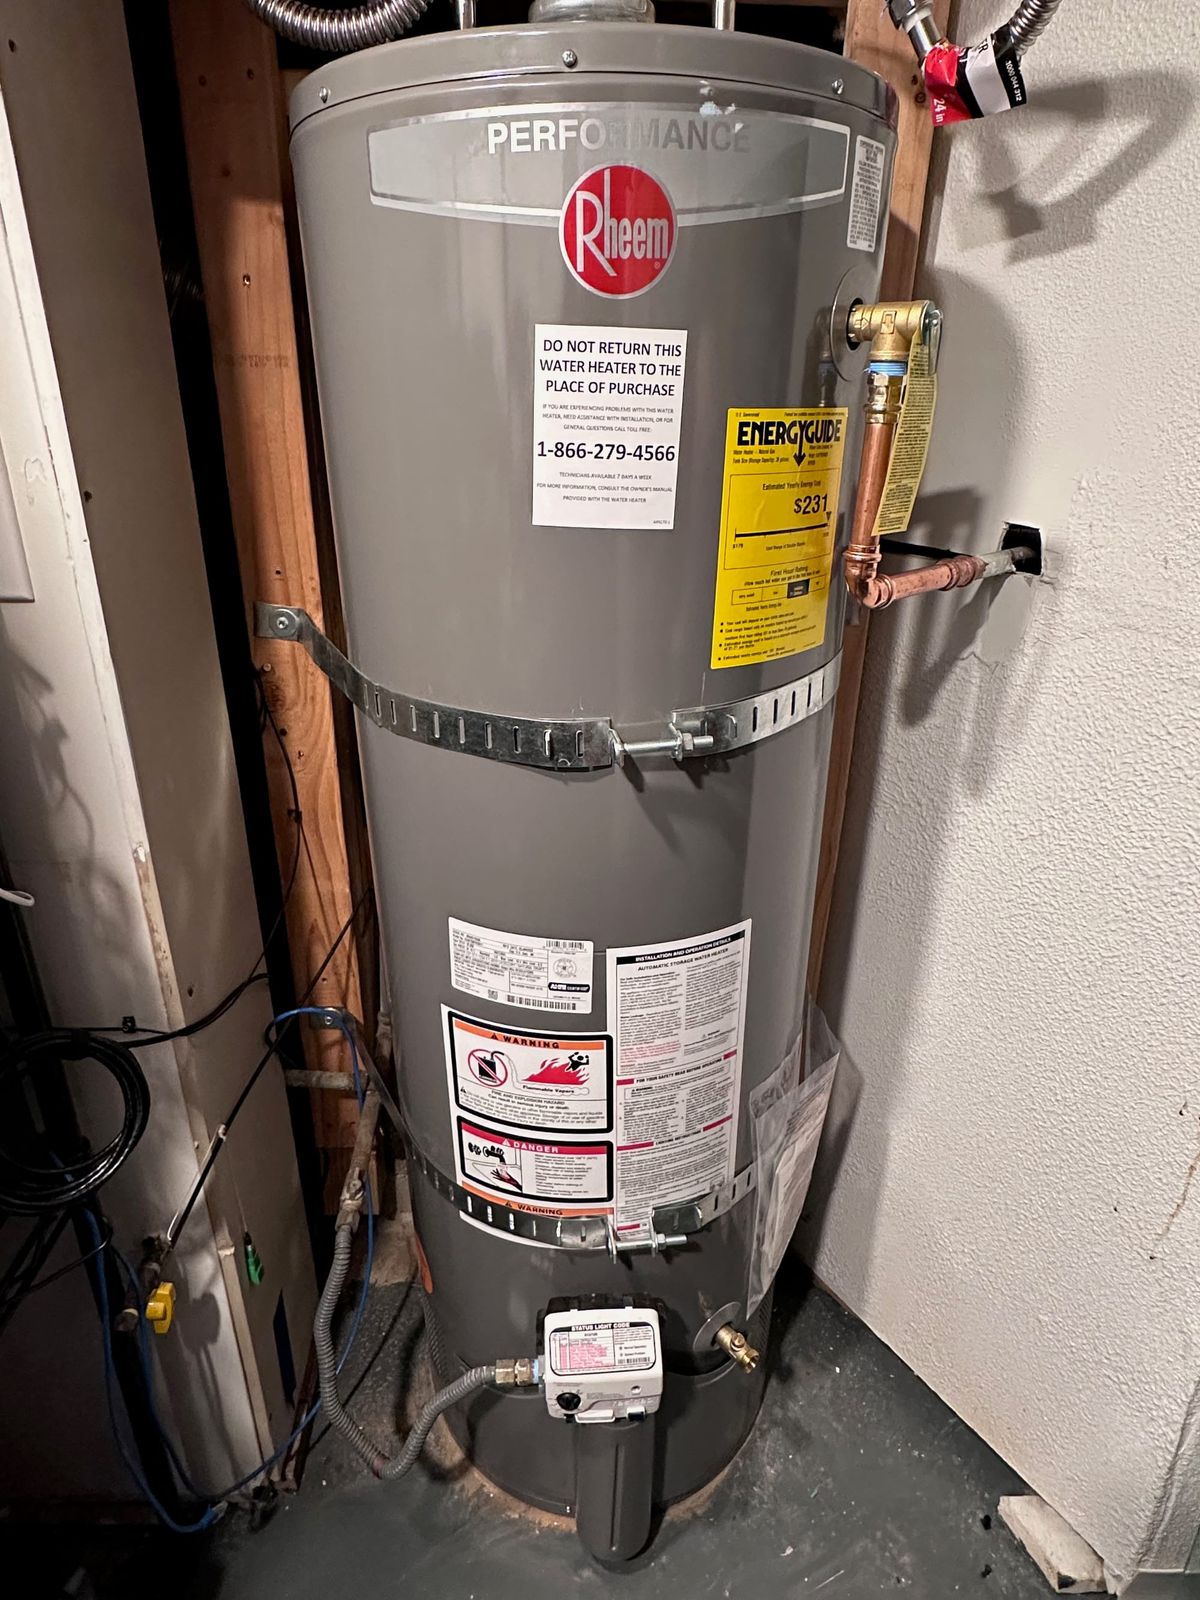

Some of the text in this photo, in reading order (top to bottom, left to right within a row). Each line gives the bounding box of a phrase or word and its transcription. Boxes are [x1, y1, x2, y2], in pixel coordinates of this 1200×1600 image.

[933, 98, 946, 123] 24 in
[576, 168, 669, 277] Rheem
[543, 339, 682, 357] DO NOT RETURN THIS
[540, 359, 681, 376] WATER HEATER TO THE
[546, 380, 675, 396] PLACE OF PURCHASE
[737, 419, 842, 446] ENERGYGUIDE
[537, 441, 675, 461] 1-866-279-4566
[793, 493, 828, 515] $231
[635, 952, 672, 962] INSTALLATION
[638, 963, 669, 971] AUTOMATIC
[503, 1035, 559, 1049] WARNING
[514, 1141, 558, 1153] DANGER
[517, 1203, 563, 1215] WARNING
[571, 1324, 594, 1332] STATUS
